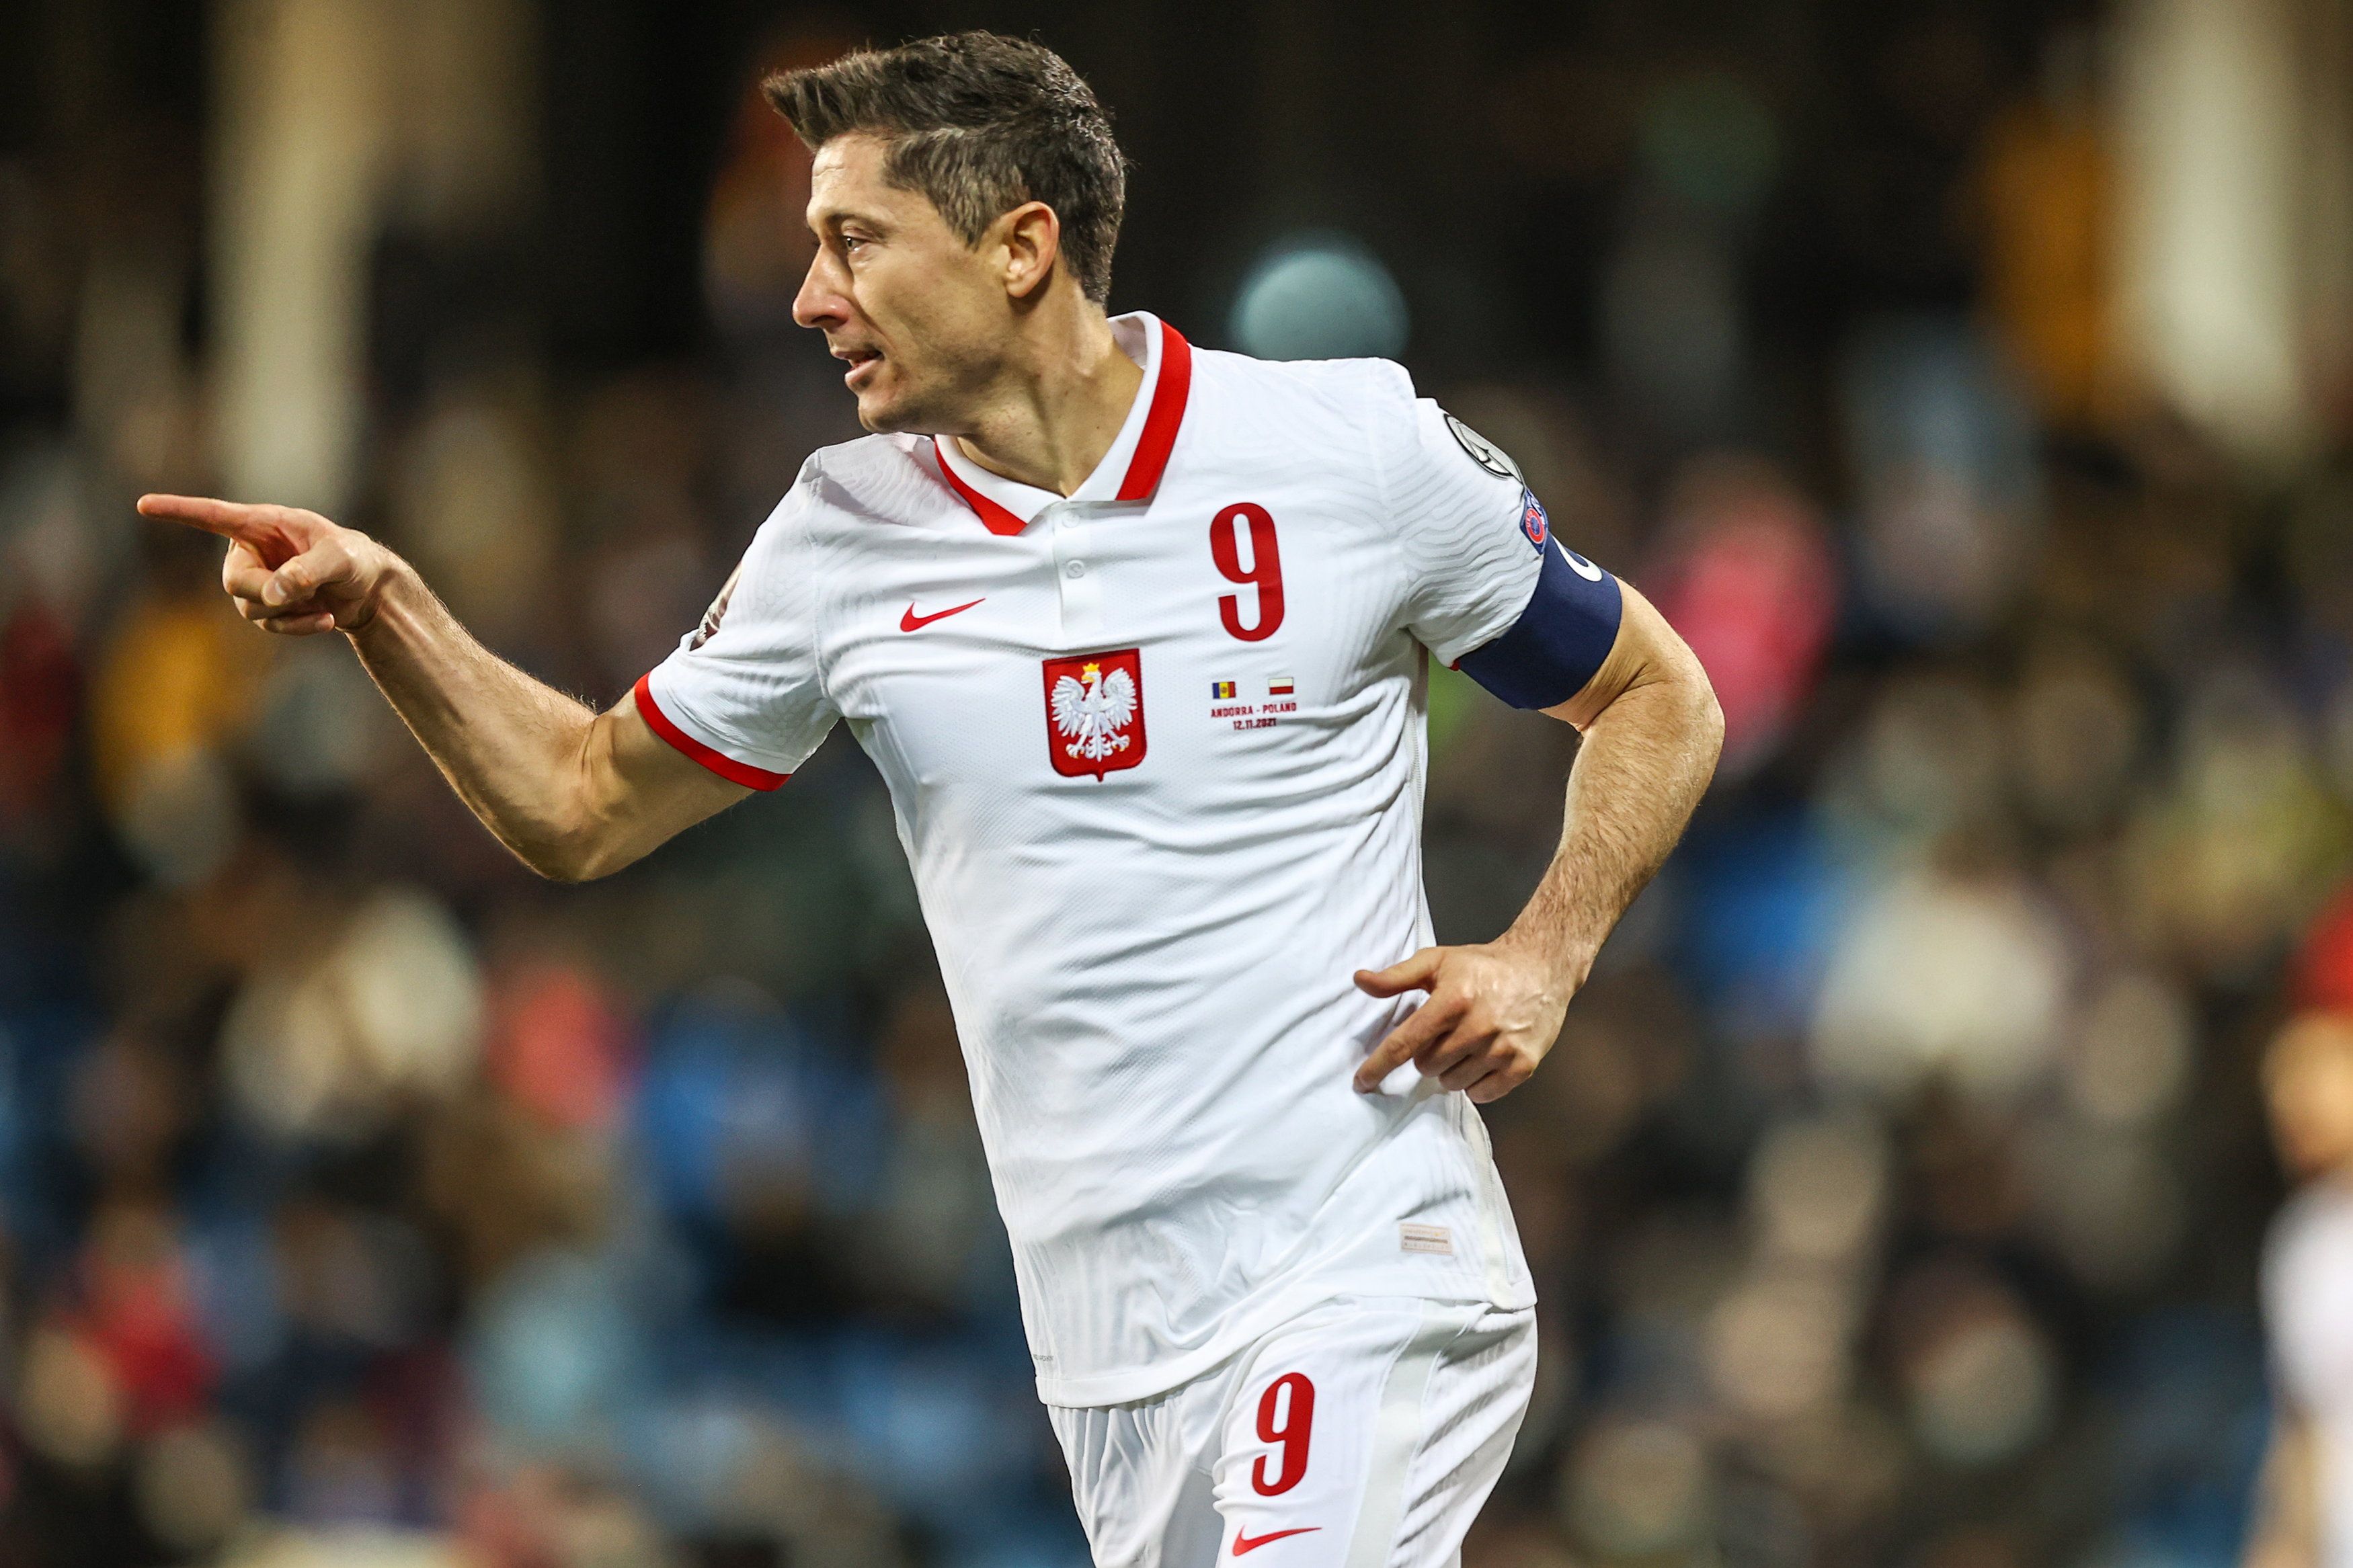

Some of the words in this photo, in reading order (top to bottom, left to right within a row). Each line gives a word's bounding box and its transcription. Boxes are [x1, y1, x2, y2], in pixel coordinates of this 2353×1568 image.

[1209, 502, 1285, 642] 9
[1211, 706, 1253, 717] ANDORRA
[1263, 702, 1297, 714] POLAND
[1233, 718, 1277, 731] 12.11.2021
[1252, 1372, 1315, 1496] 9
